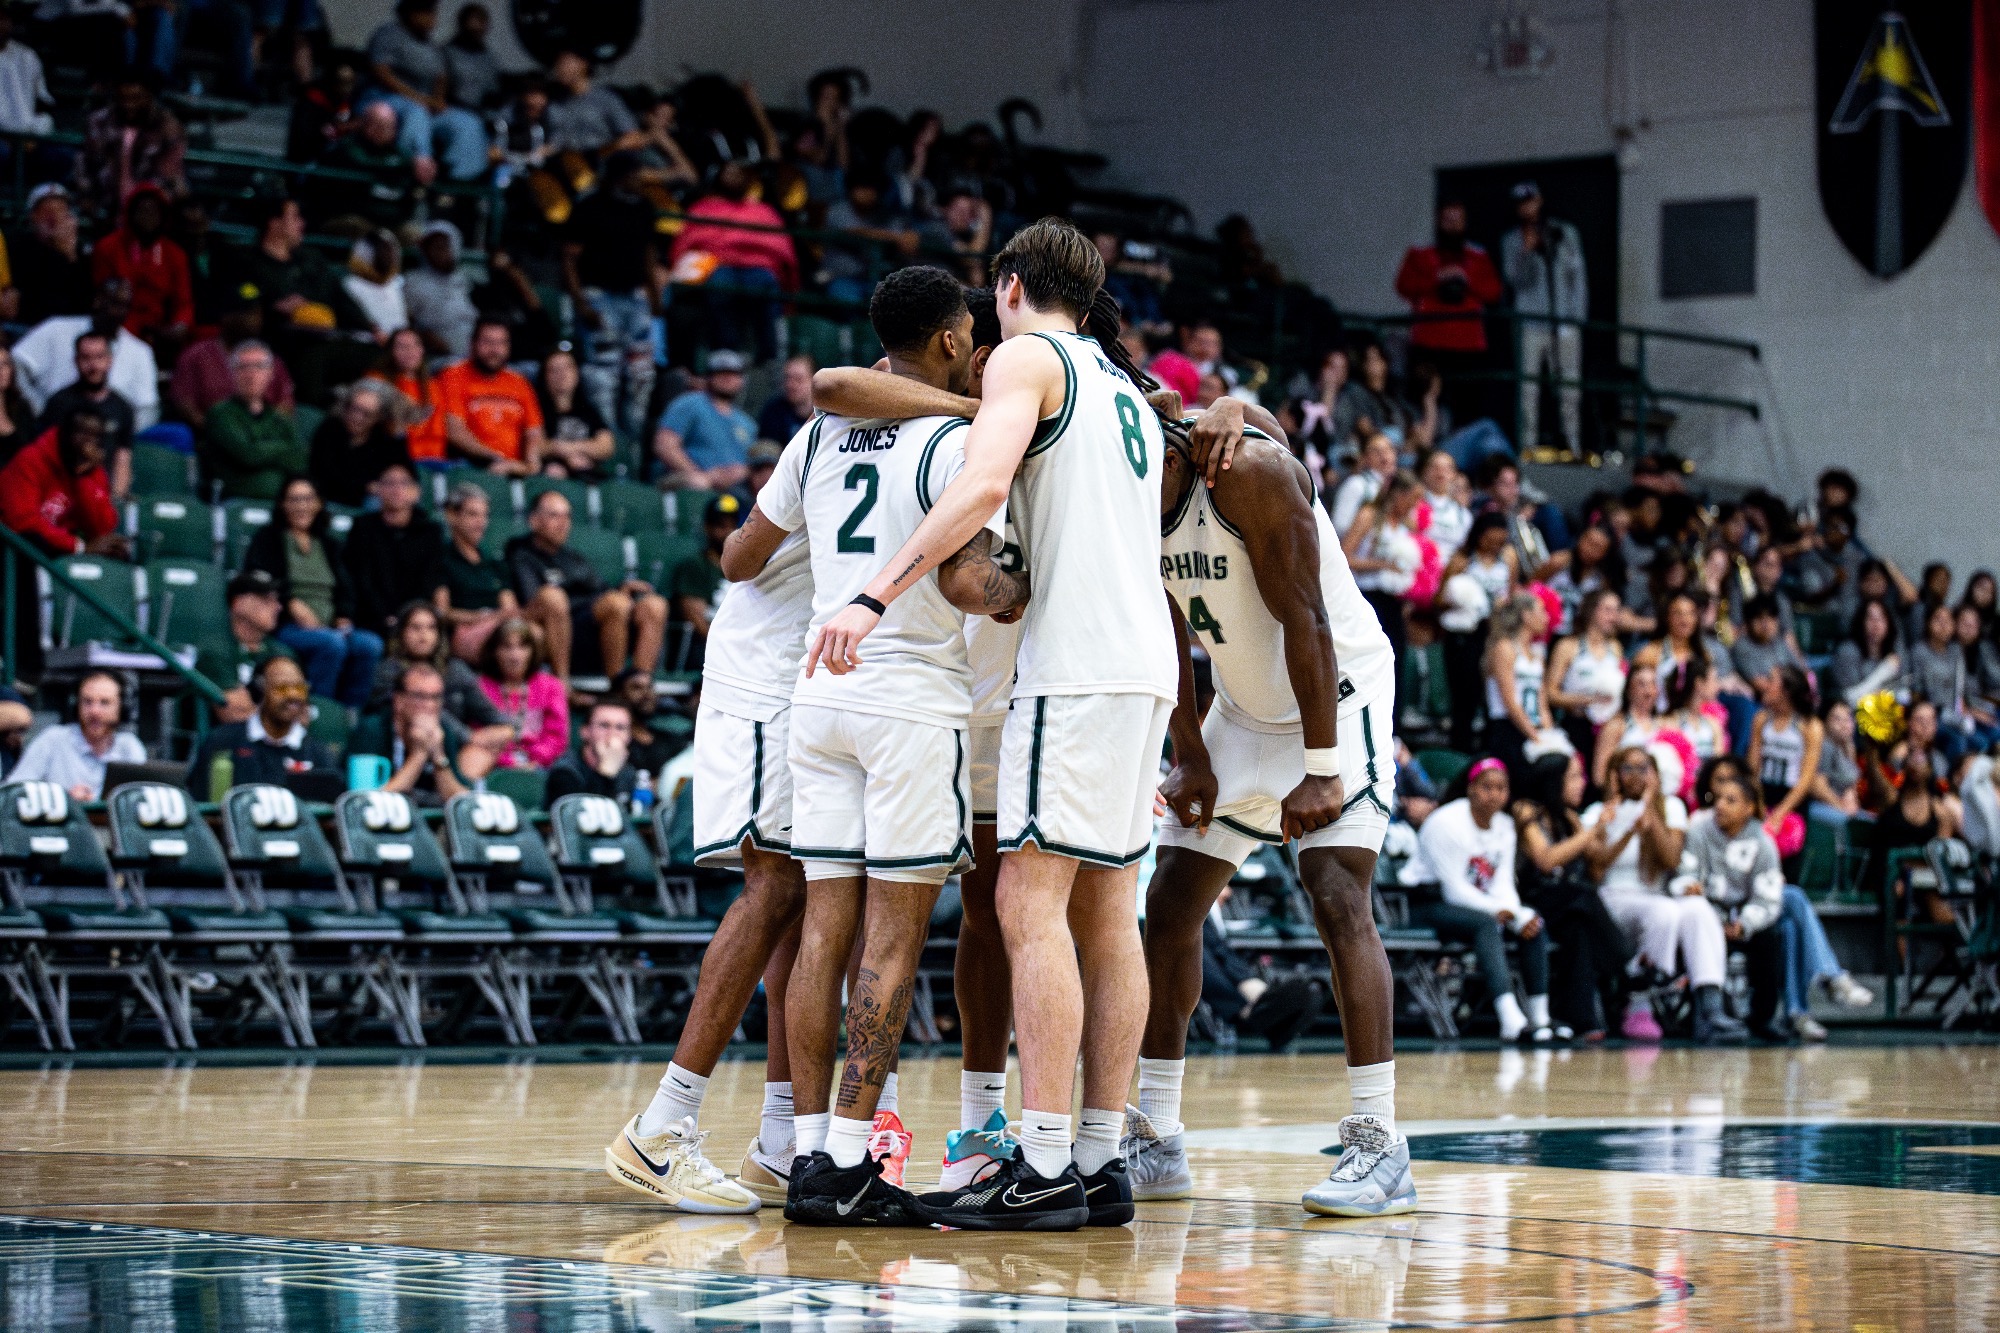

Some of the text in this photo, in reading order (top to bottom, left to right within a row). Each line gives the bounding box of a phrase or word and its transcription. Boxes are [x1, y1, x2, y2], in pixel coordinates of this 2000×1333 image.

[839, 425, 899, 453] JONES
[1114, 391, 1148, 480] 8
[837, 462, 879, 555] 2
[1161, 551, 1228, 580] PHINS
[1189, 595, 1227, 644] 4
[17, 781, 68, 823] JU
[137, 786, 188, 828] JU
